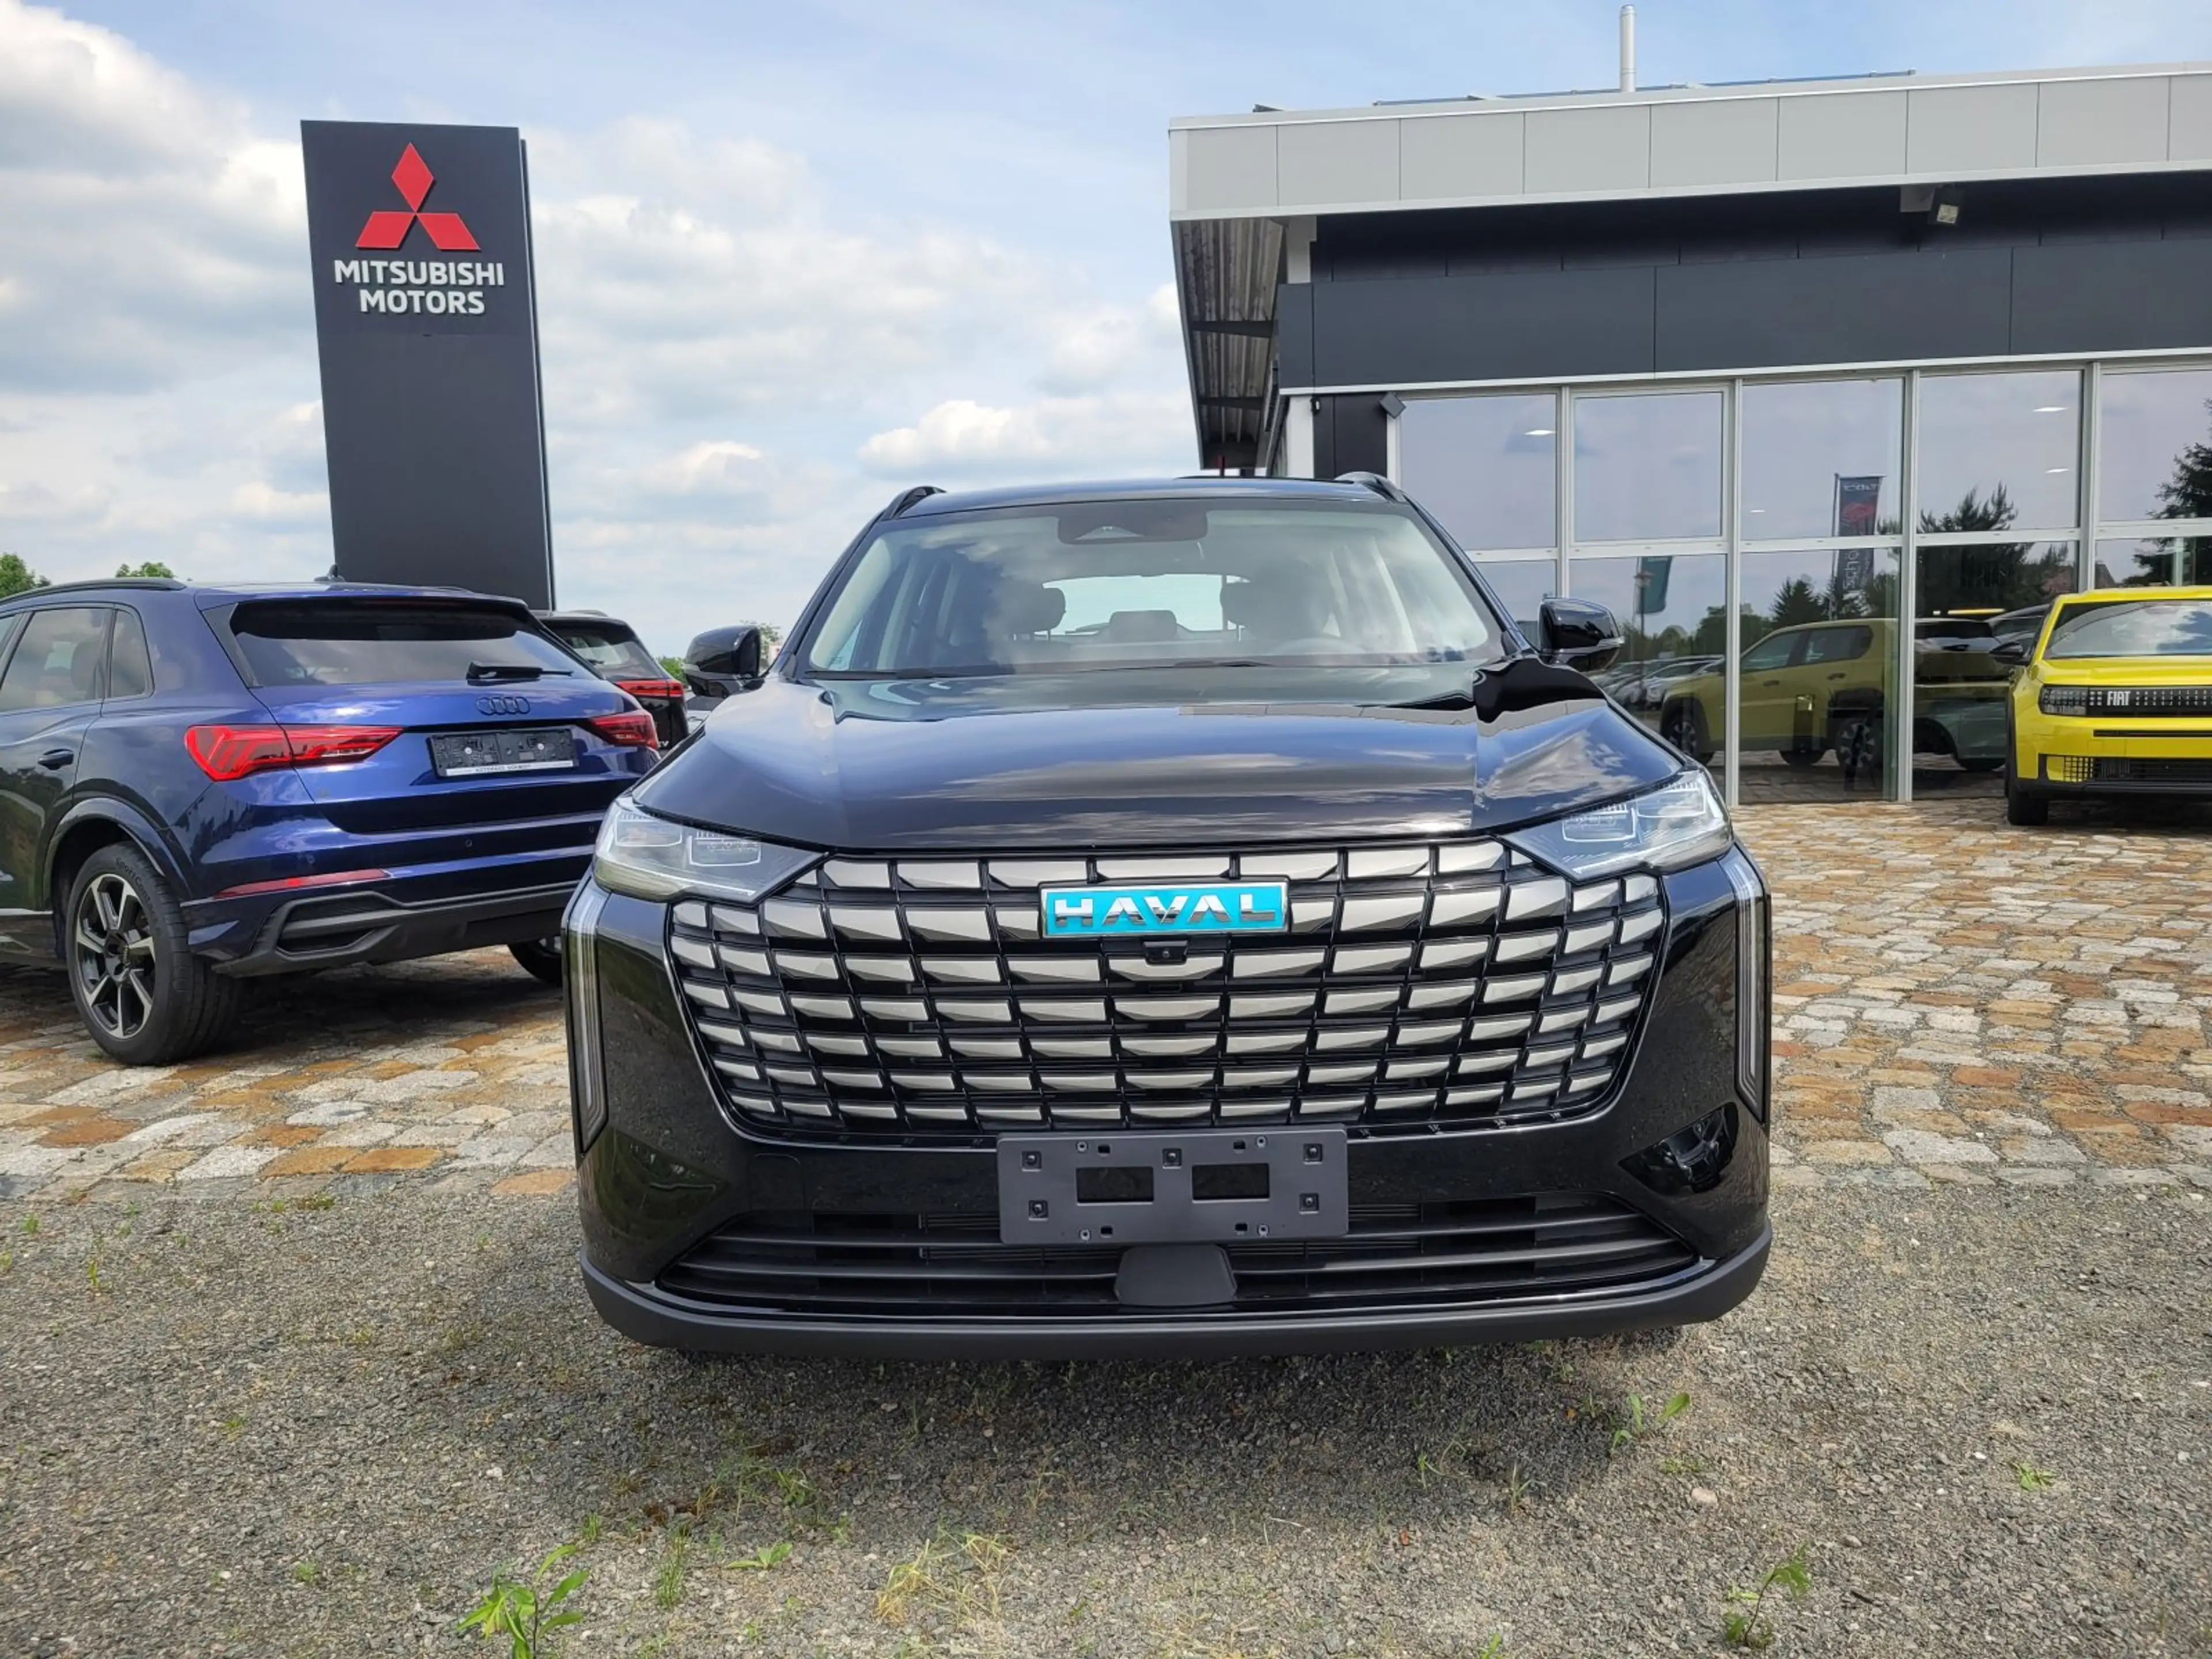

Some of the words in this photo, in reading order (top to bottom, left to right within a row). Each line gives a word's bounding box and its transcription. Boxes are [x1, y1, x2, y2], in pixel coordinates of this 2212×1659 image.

[334, 259, 504, 286] MITSUBISHI
[359, 289, 486, 314] MOTORS
[2107, 691, 2131, 706] FIAT
[1054, 893, 1276, 927] HAVAL
